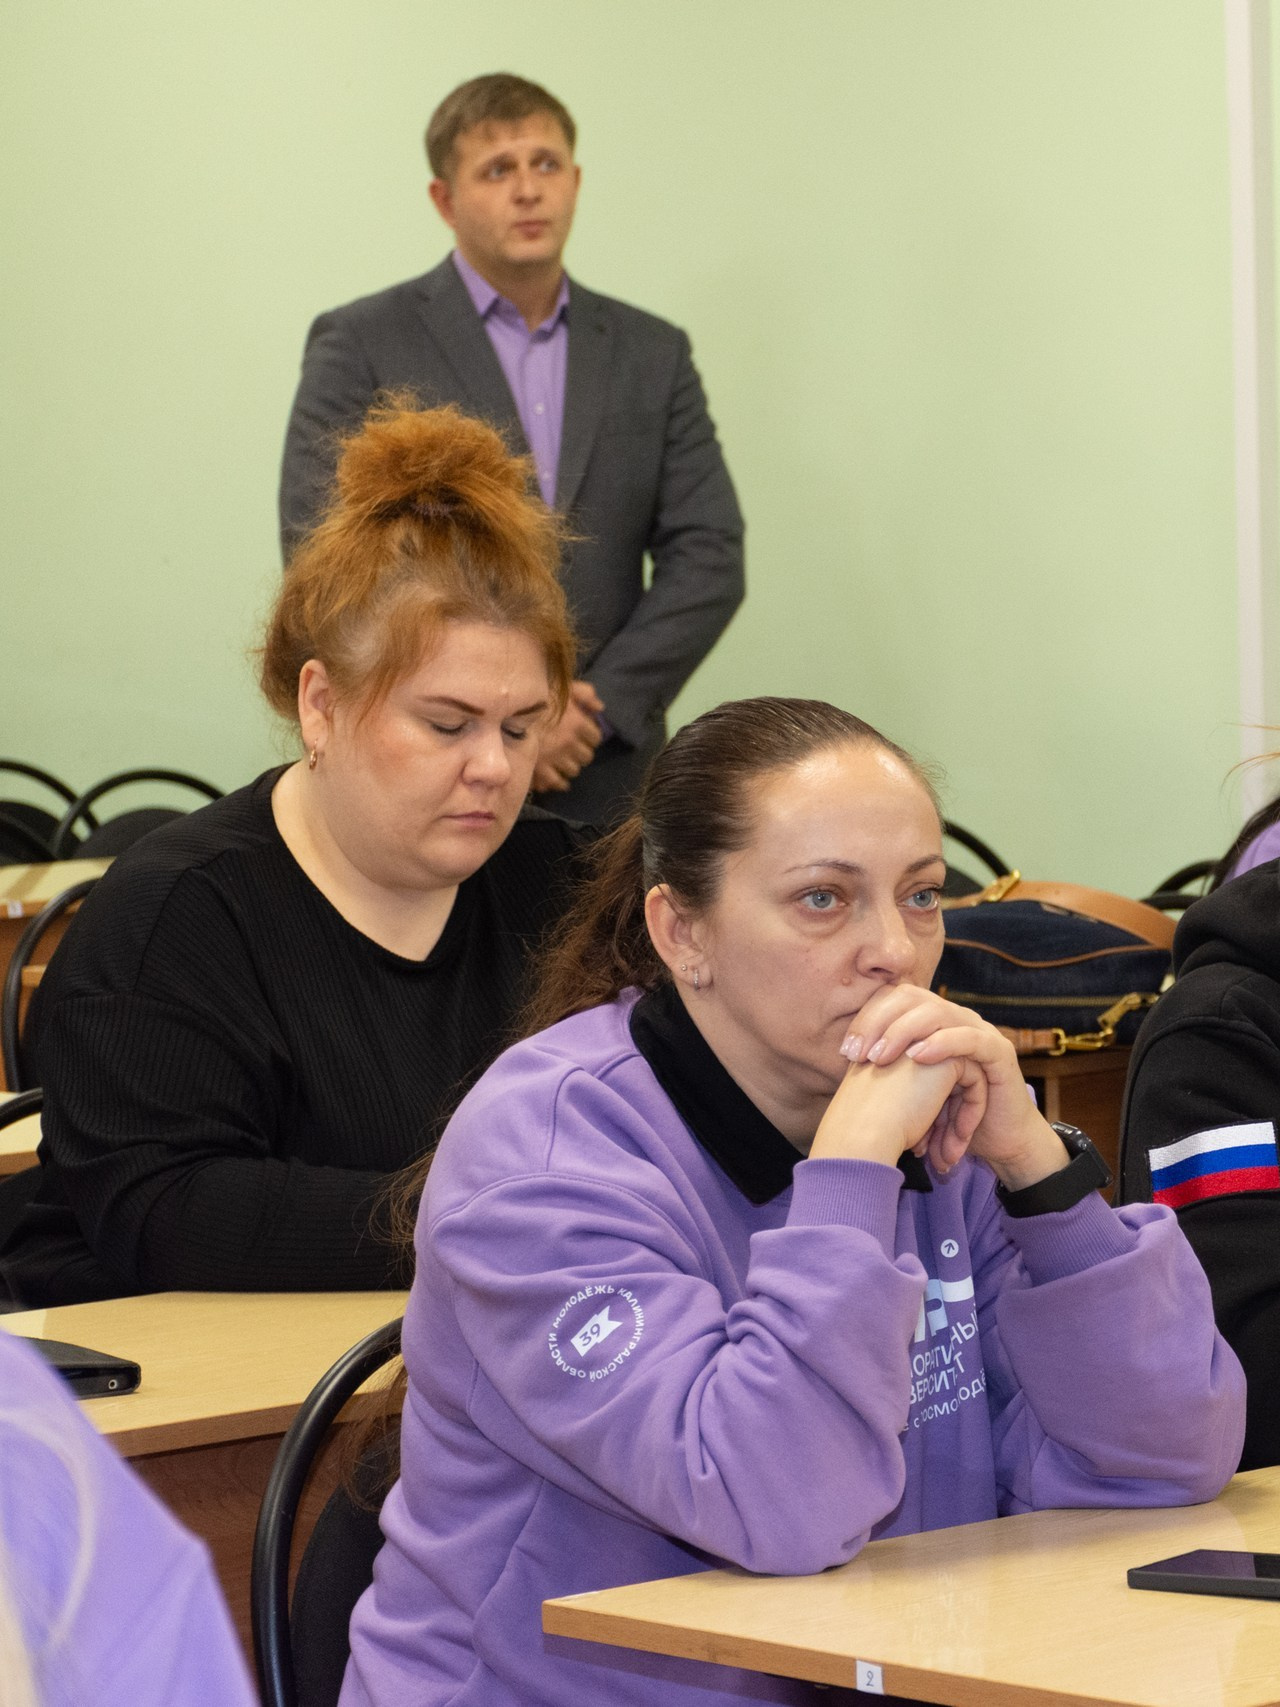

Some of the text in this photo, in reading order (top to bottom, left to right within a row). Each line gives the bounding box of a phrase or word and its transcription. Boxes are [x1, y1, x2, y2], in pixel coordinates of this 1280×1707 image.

[548, 1284, 645, 1382] МОЛОДЁЖЬ КАЛИНИНГРАДСКОЙ ОБЛАСТИ
[579, 1323, 601, 1347] 39
[865, 1670, 875, 1687] 2
